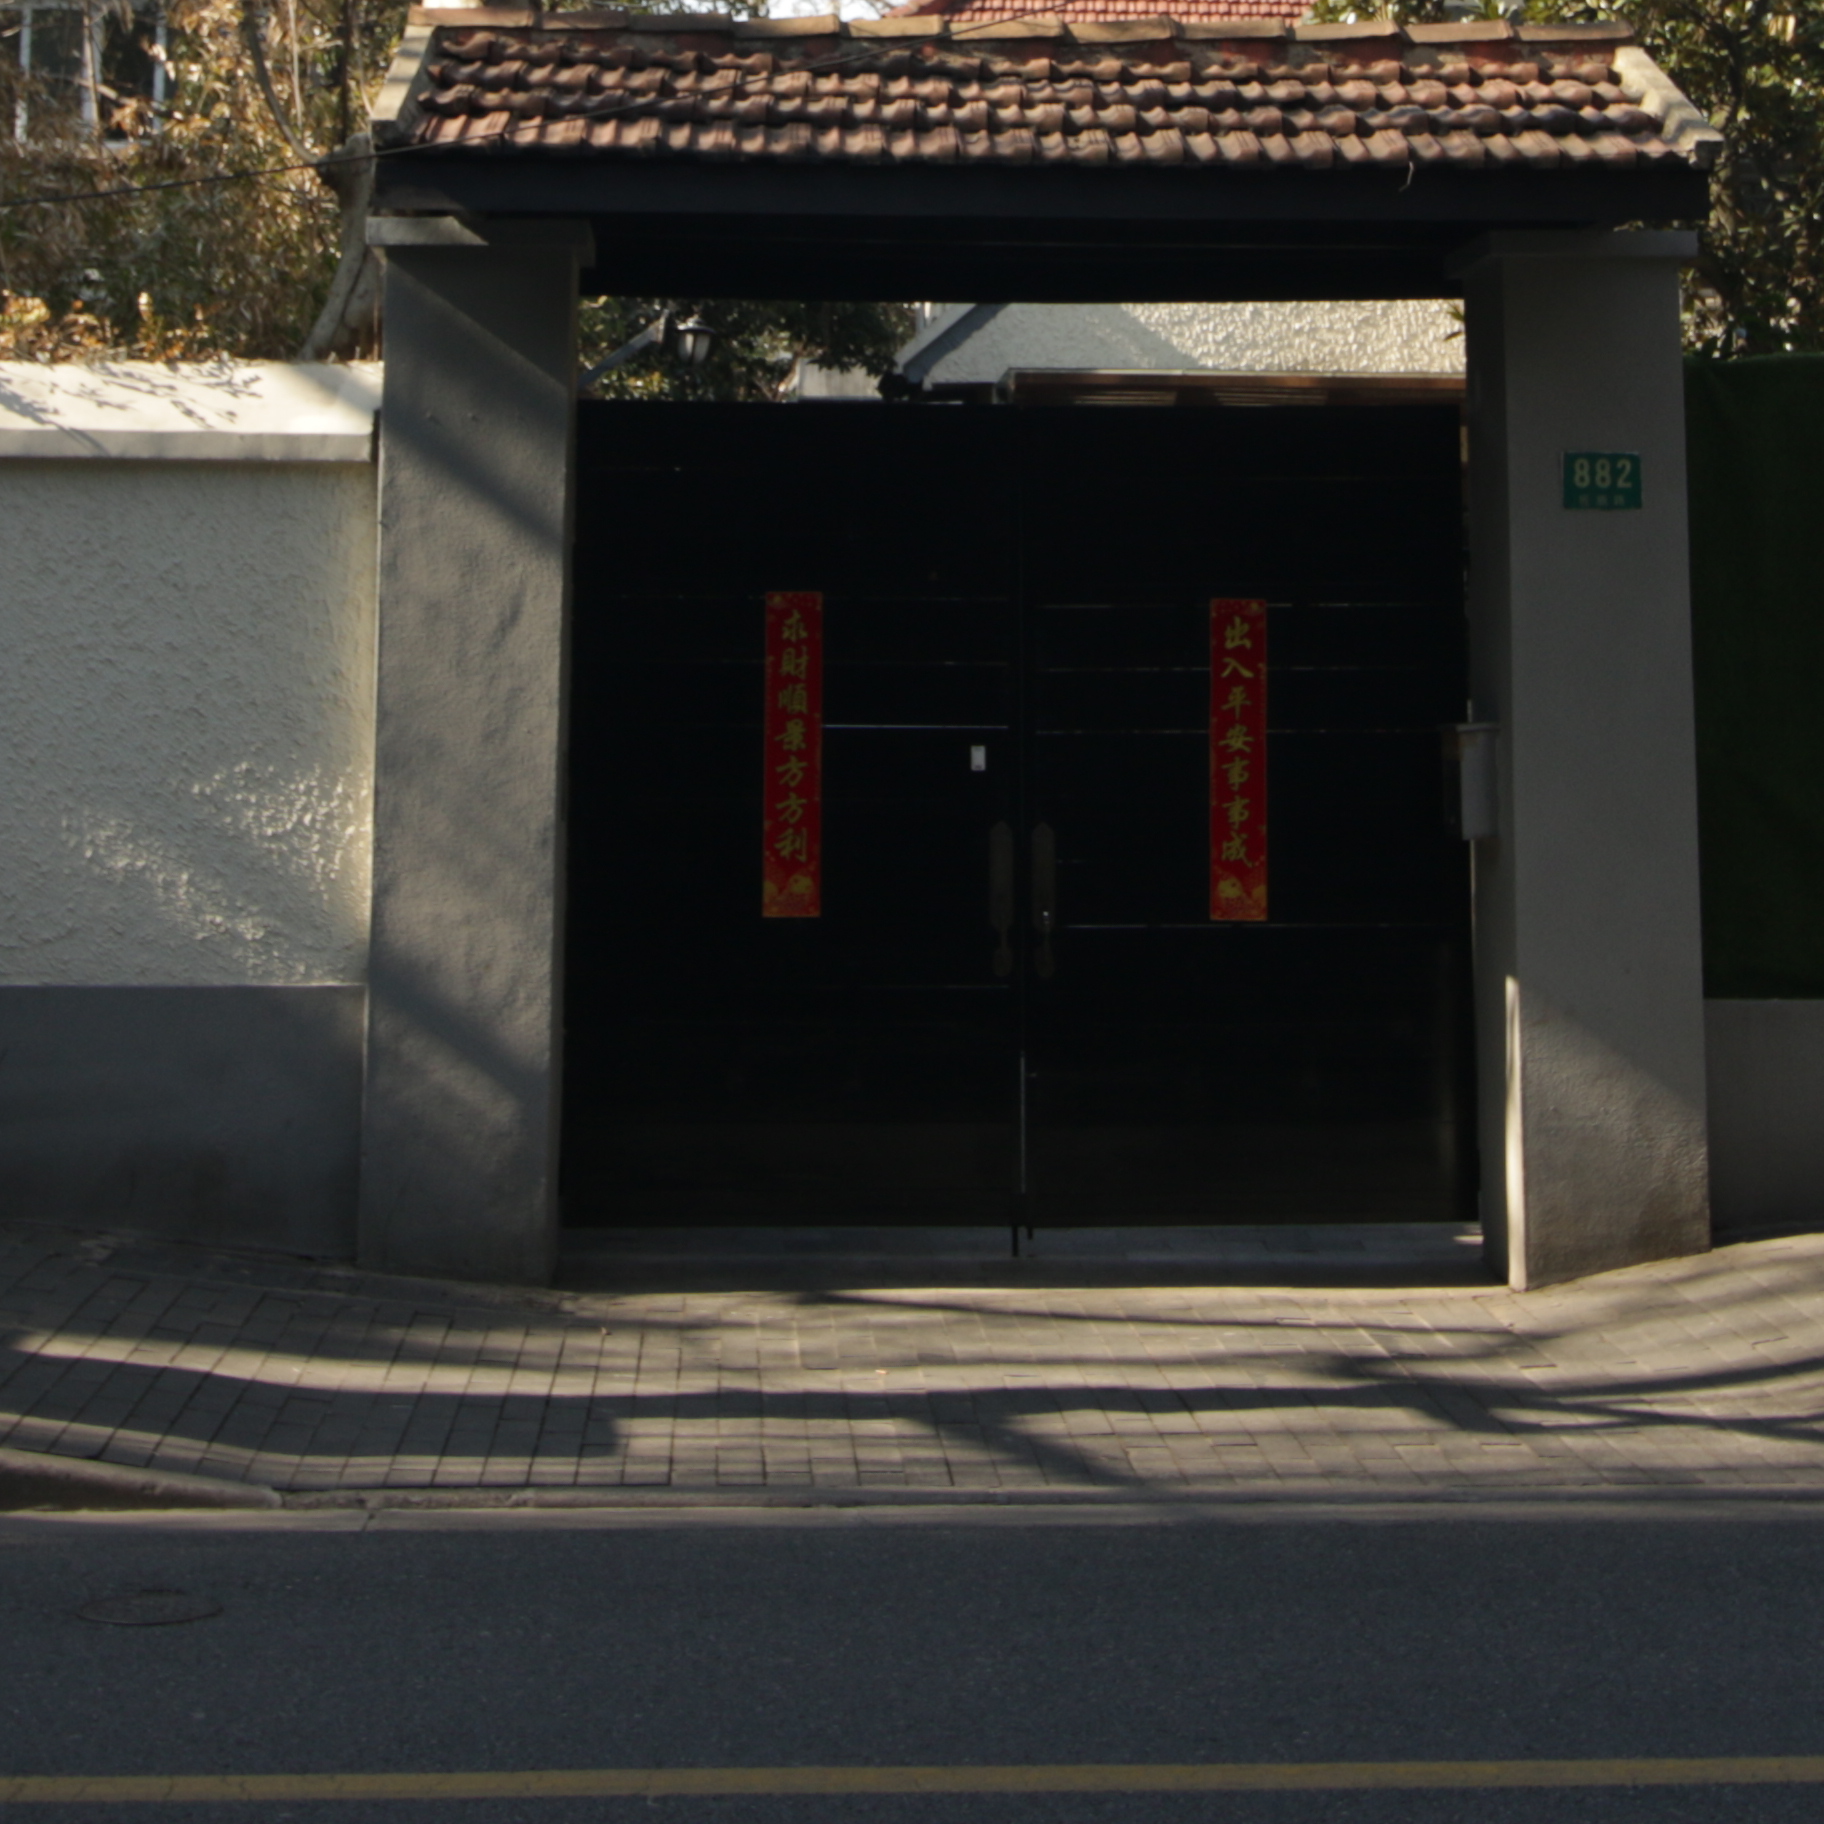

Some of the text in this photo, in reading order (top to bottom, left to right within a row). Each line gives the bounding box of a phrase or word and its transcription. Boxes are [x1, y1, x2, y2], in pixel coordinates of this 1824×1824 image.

[1573, 457, 1633, 489] 882
[1218, 615, 1255, 869] 出入平安事事成
